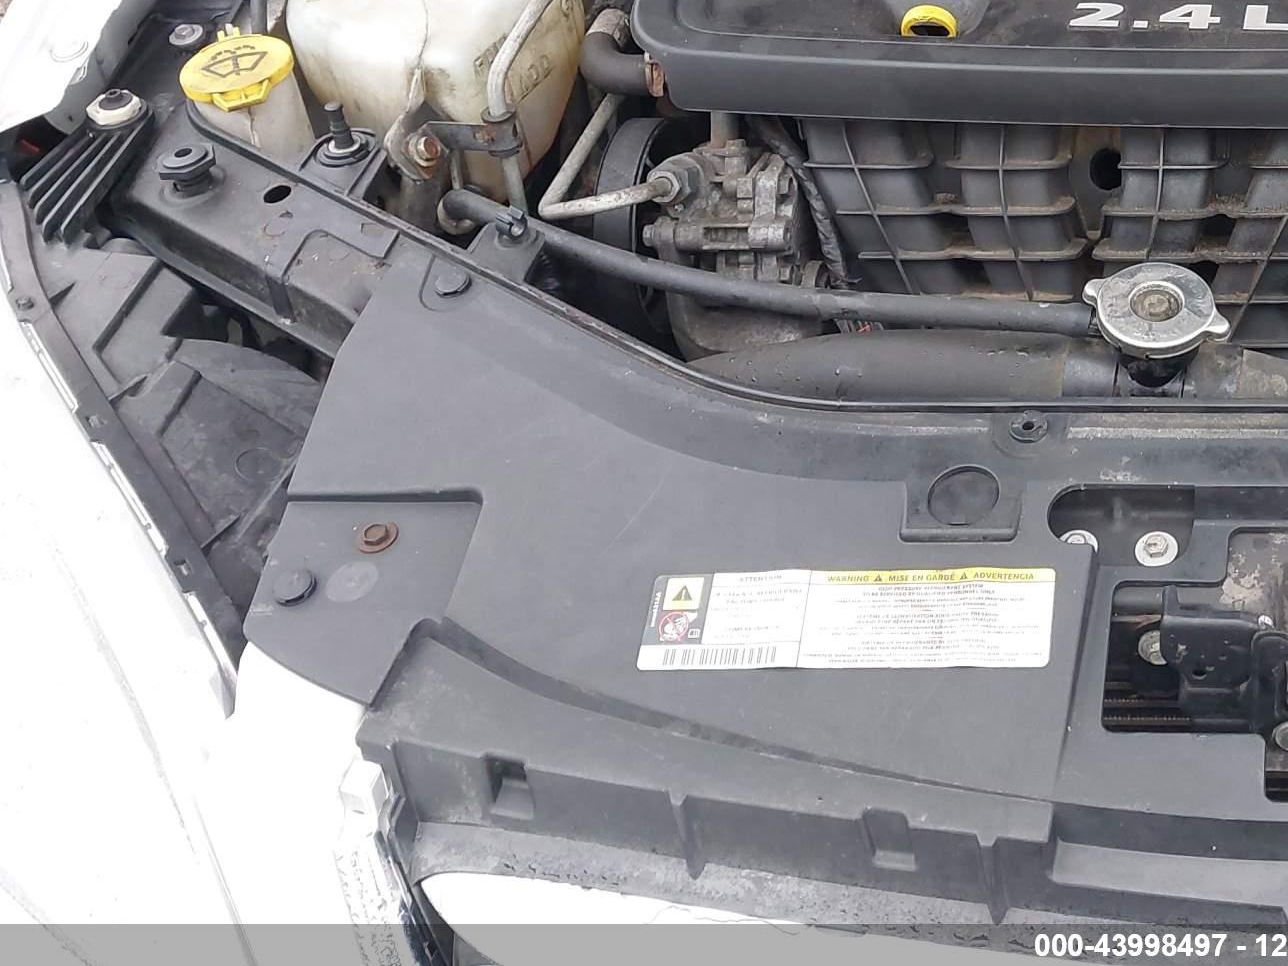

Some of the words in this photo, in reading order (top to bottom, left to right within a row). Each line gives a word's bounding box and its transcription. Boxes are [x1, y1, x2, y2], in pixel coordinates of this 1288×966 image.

[827, 575, 869, 583] WARNING
[888, 574, 909, 582] MISE
[912, 574, 924, 582] EN
[973, 571, 1034, 581] ADVERTENCIA
